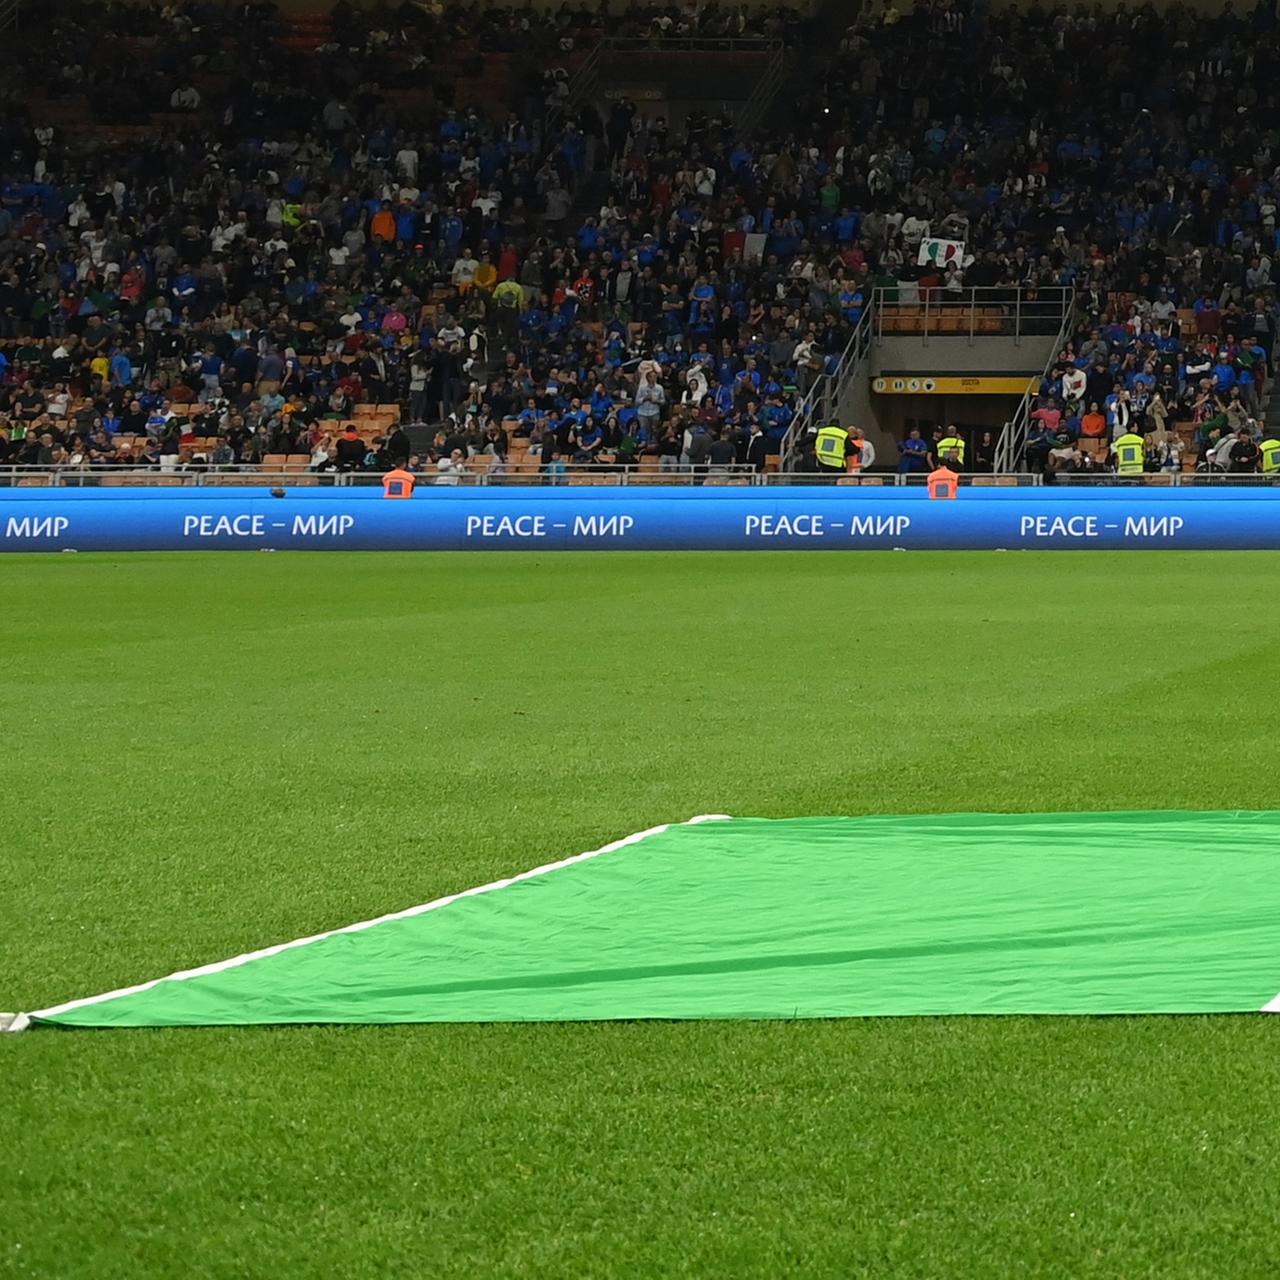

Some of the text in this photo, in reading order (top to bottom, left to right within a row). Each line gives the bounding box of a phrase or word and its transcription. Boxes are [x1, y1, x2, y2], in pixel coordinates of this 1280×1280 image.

[6, 517, 69, 537] МИР
[184, 515, 265, 536] PEACE
[292, 515, 355, 535] МИР
[467, 515, 546, 536] PEACE
[573, 515, 634, 535] МИР
[745, 515, 824, 536] PEACE
[850, 515, 911, 535] МИР
[1021, 516, 1098, 537] PEACE
[1124, 516, 1184, 536] МИР
